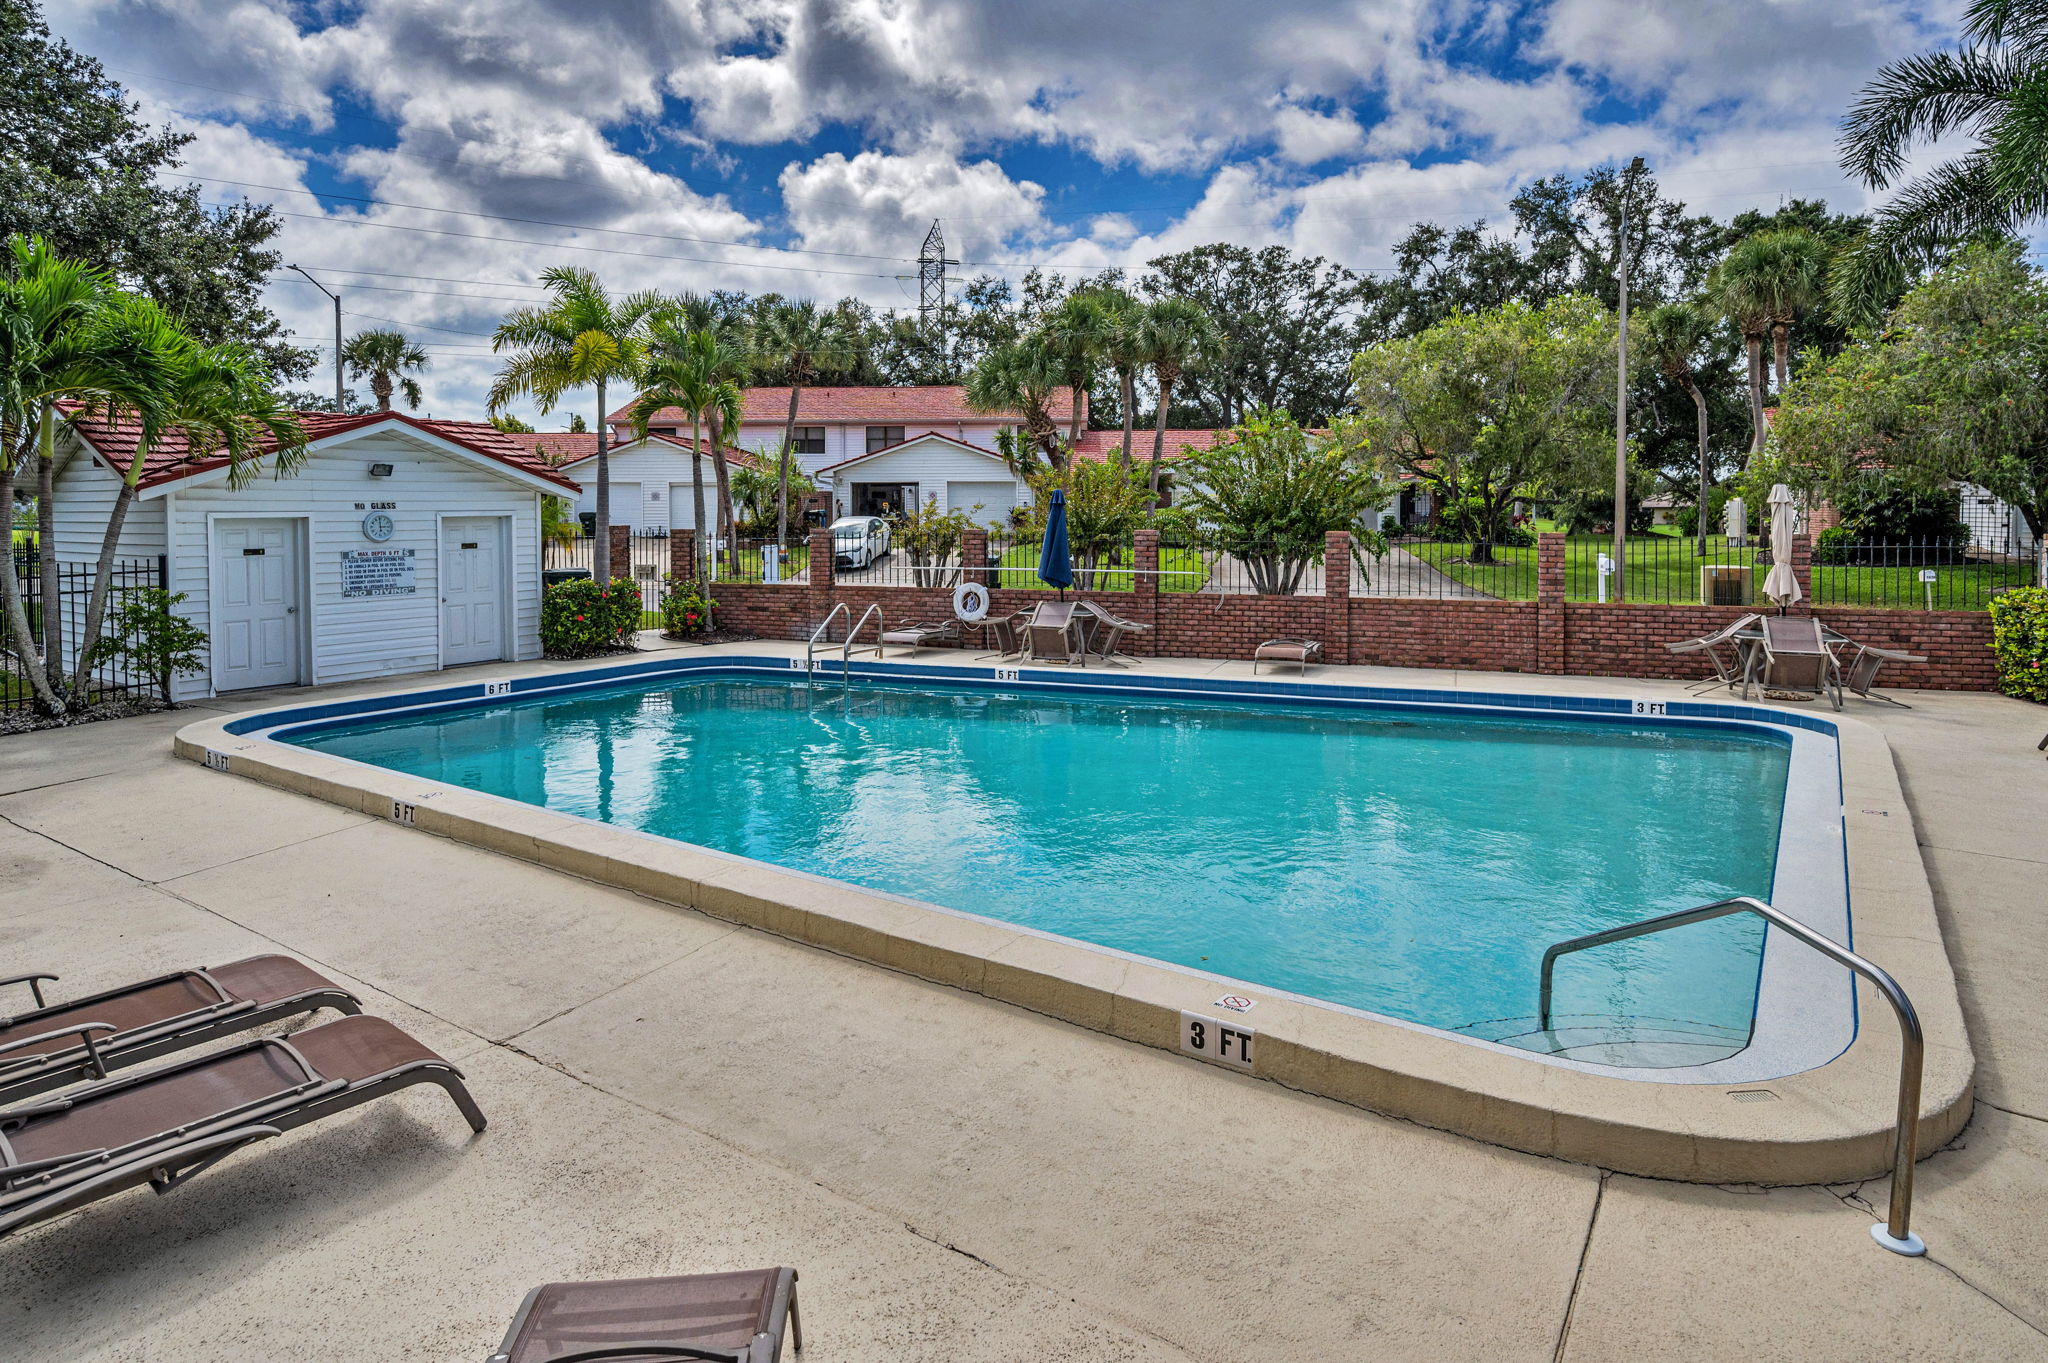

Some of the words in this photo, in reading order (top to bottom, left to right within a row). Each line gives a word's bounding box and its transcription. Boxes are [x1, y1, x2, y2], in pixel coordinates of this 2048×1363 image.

[793, 660, 797, 668] 5
[998, 671, 1003, 679] 5
[489, 685, 494, 694] 6
[1637, 702, 1644, 713] 3
[1650, 704, 1664, 715] FT.
[208, 751, 211, 764] 5
[395, 802, 400, 818] 5
[1190, 1022, 1205, 1049] 3
[1221, 1027, 1251, 1063] FT.
